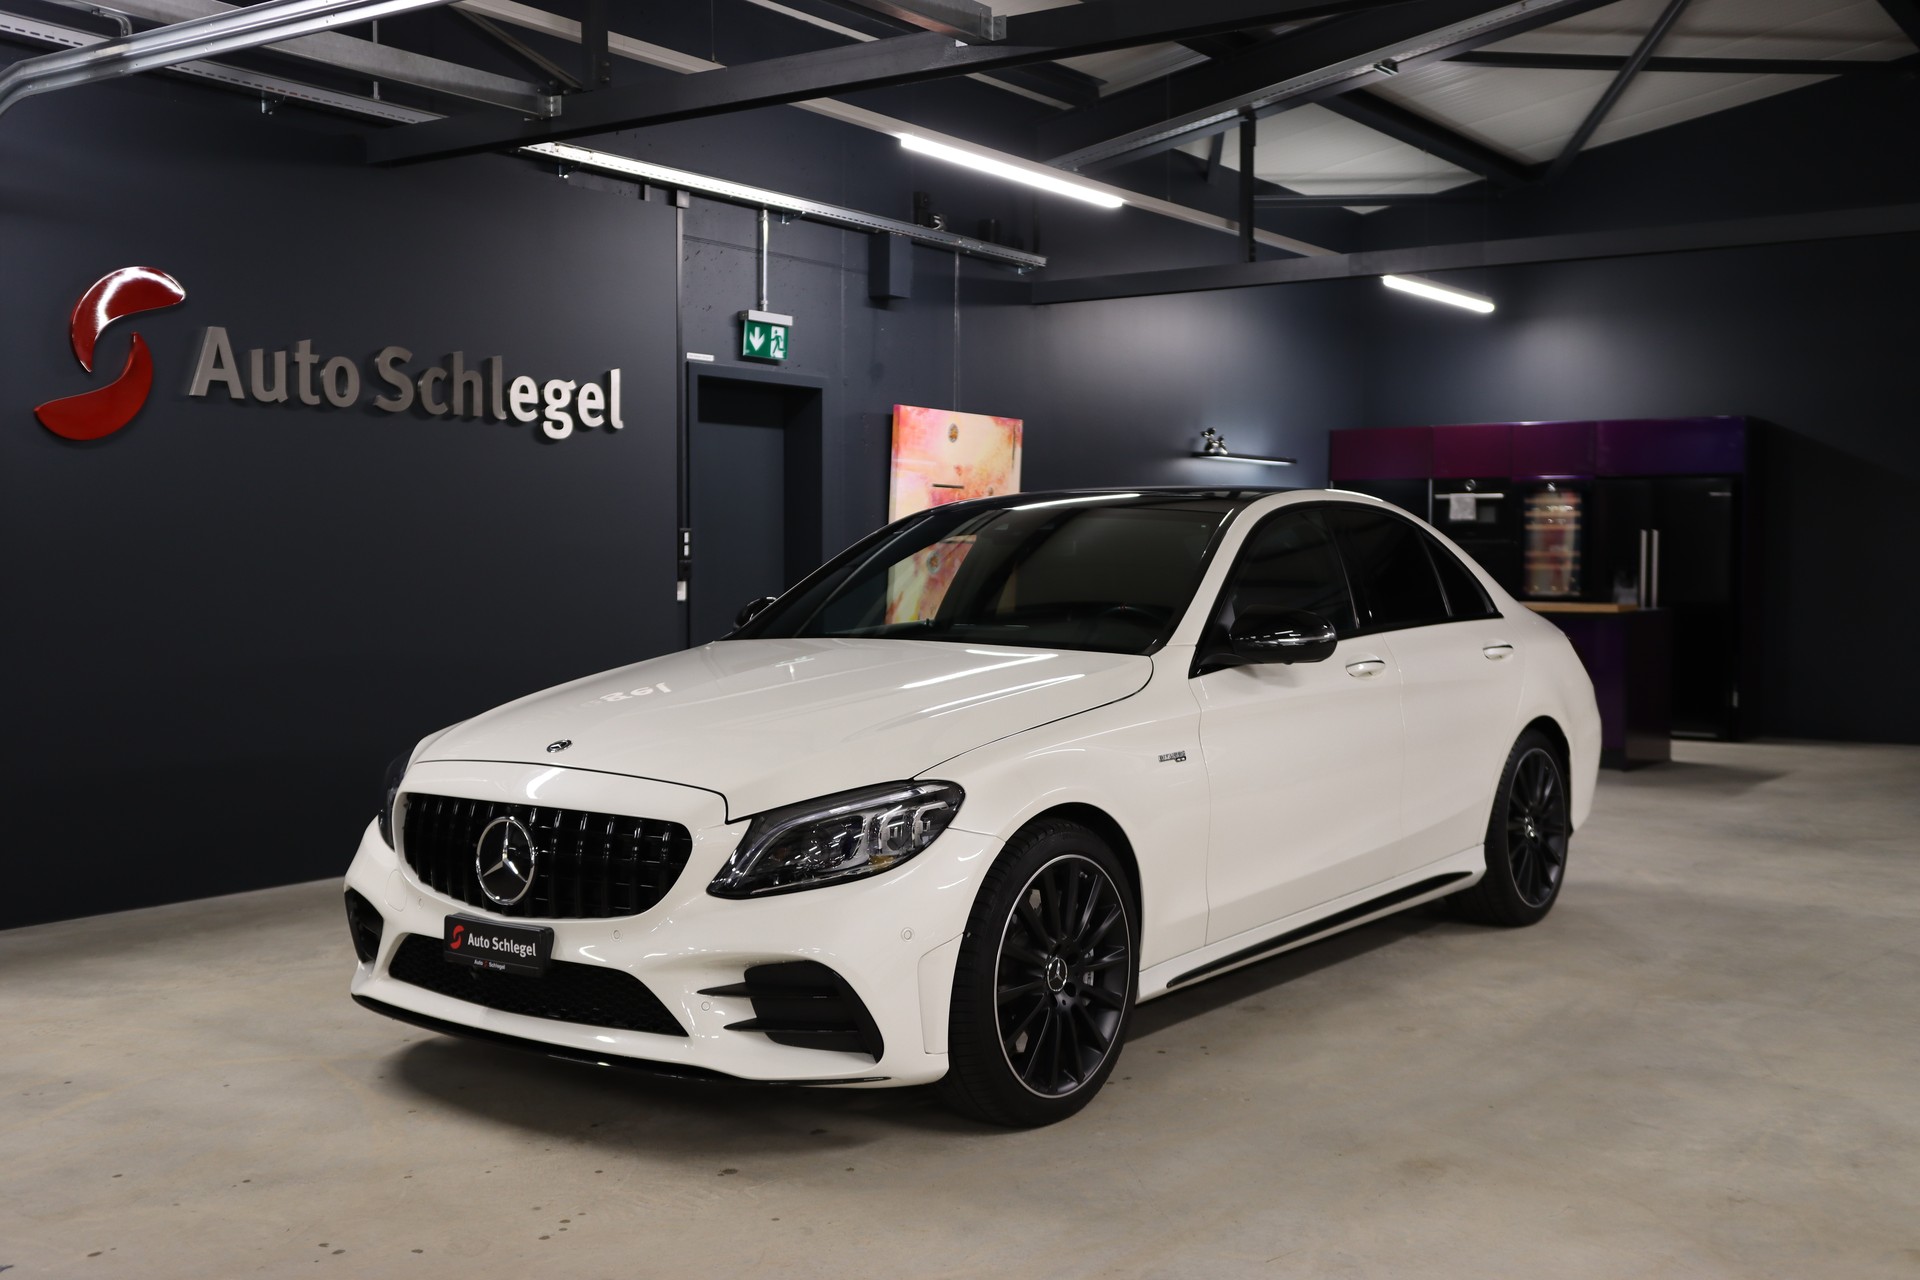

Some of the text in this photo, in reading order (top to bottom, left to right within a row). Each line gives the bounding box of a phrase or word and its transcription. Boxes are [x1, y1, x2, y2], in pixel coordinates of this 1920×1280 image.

[189, 326, 624, 440] Auto Schlegel
[467, 932, 537, 958] Auto Schlegel
